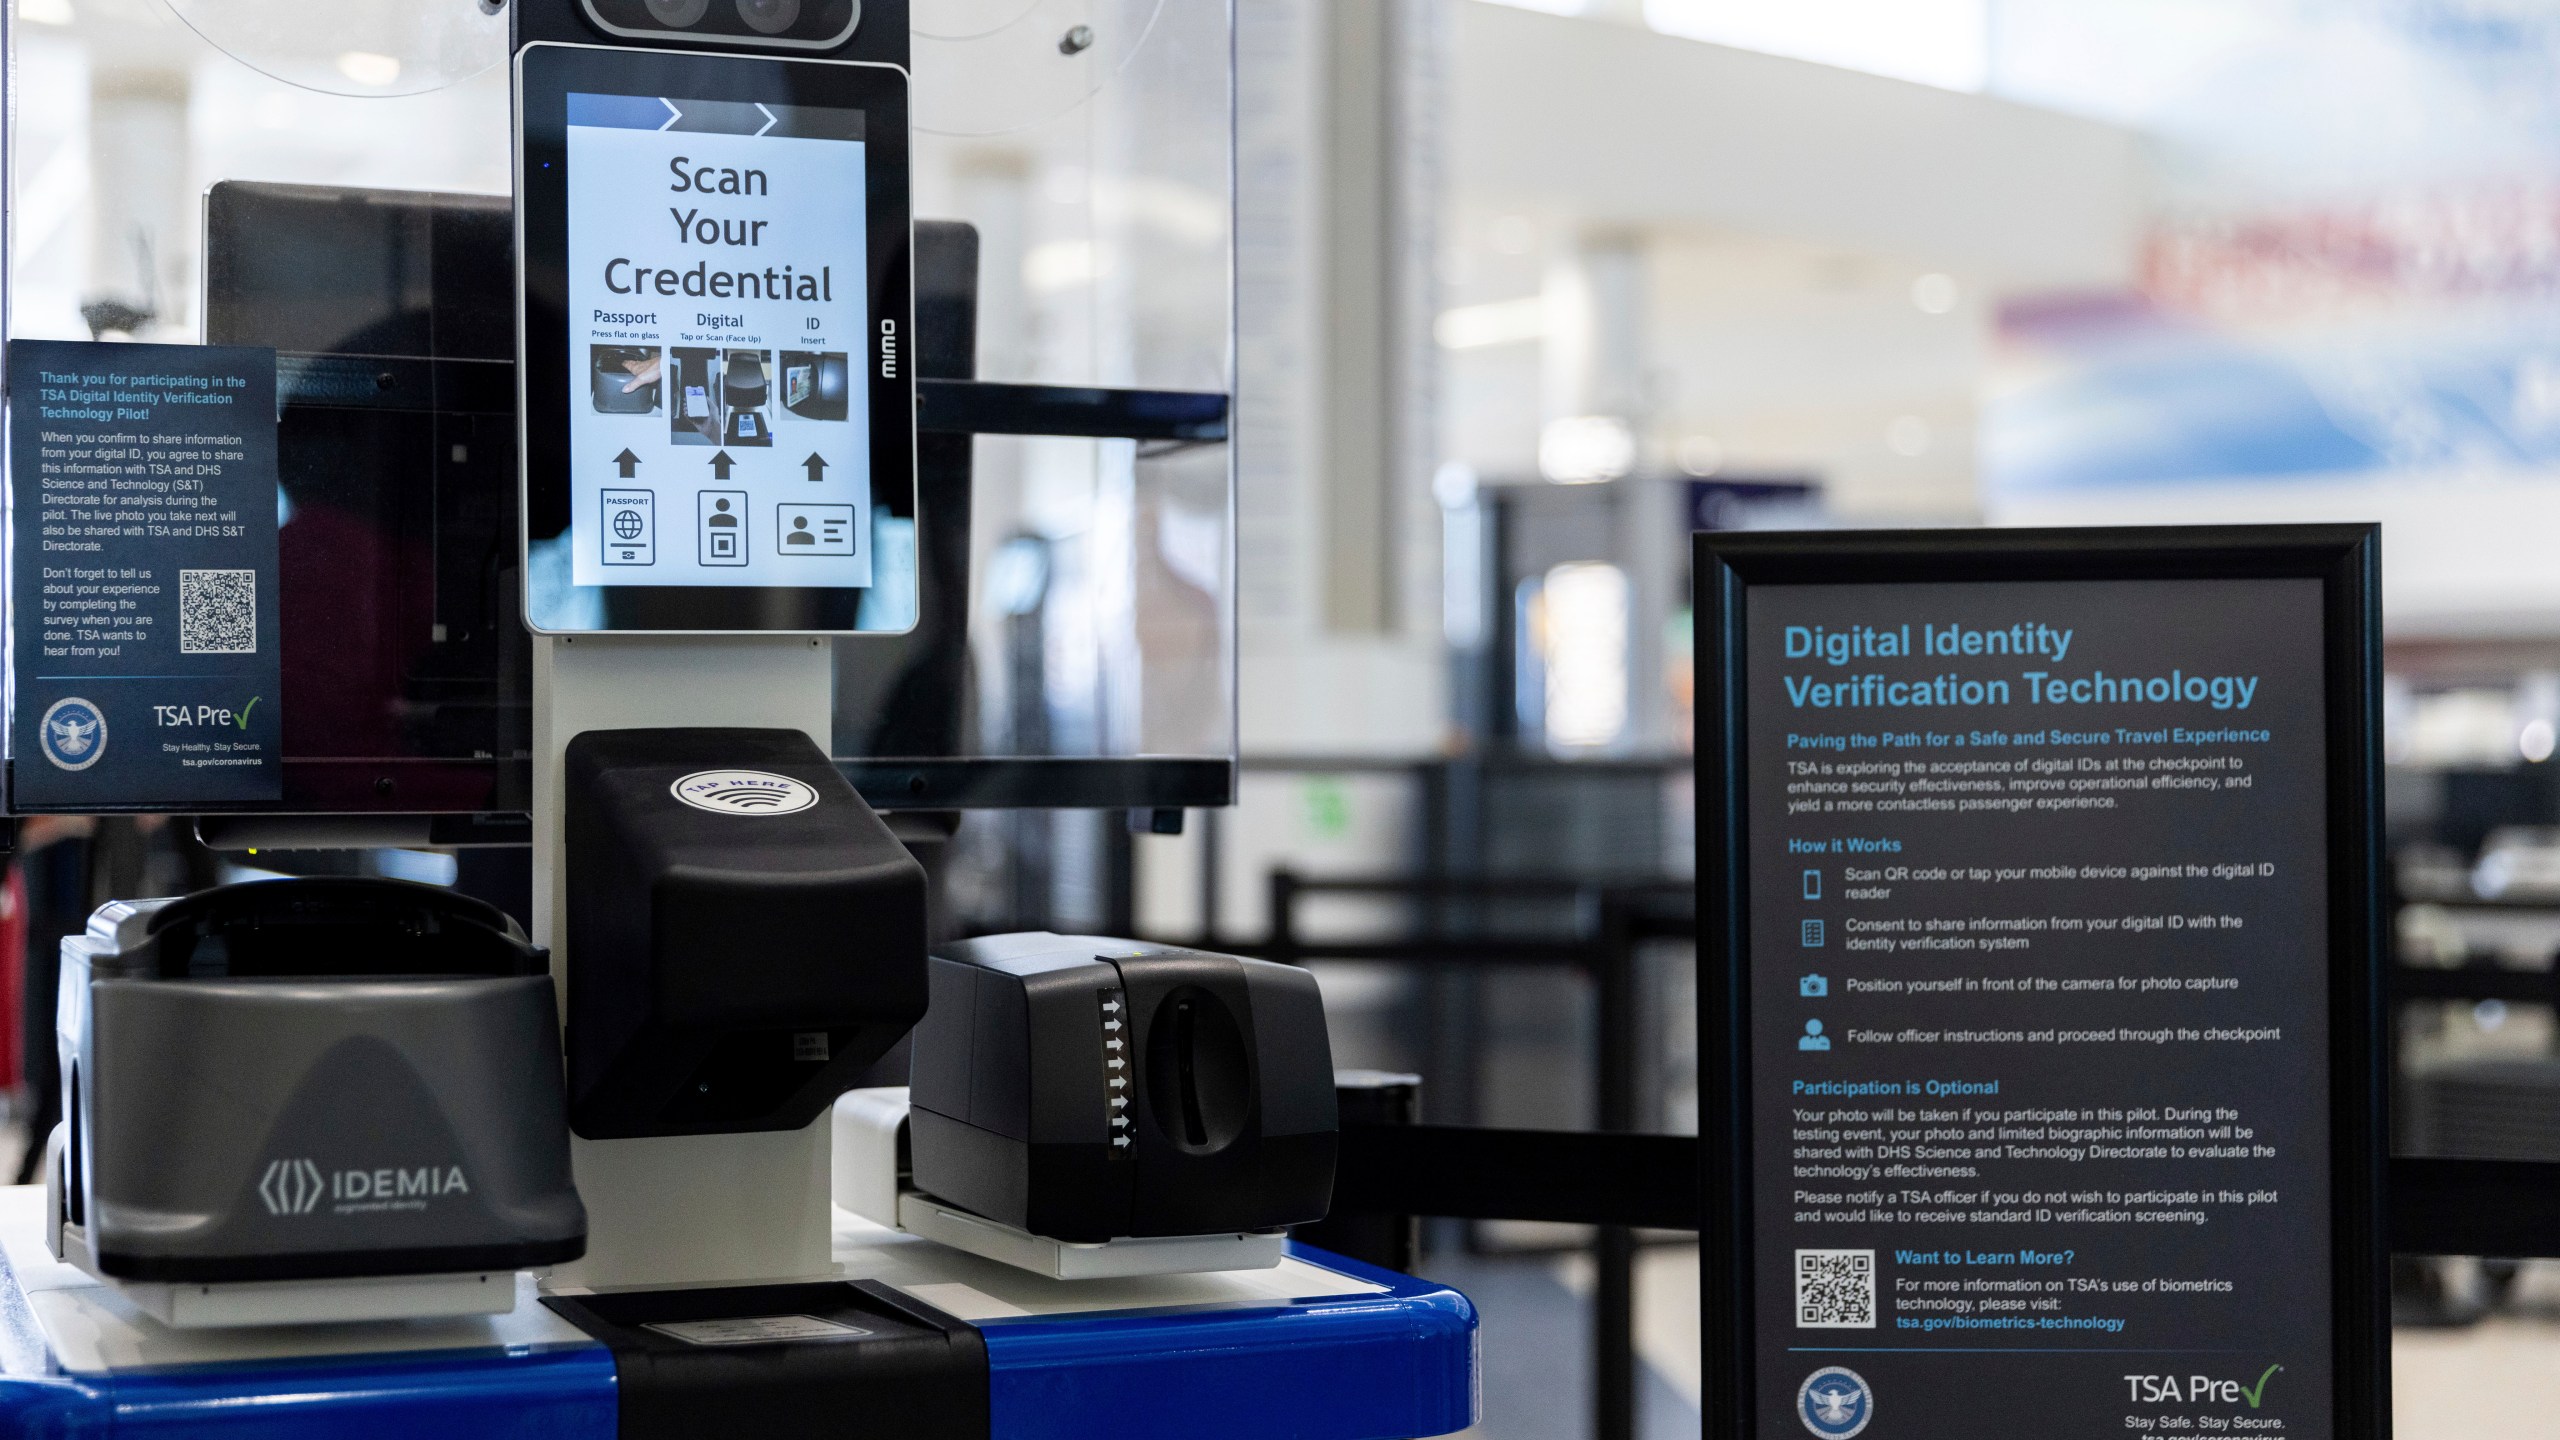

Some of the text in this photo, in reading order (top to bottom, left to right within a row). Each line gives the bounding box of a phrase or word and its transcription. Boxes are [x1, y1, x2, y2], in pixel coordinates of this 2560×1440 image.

[670, 156, 767, 196] Scan
[669, 207, 768, 246] Your
[604, 257, 832, 302] Credential
[594, 309, 657, 326] Passport
[696, 313, 743, 330] Digital
[806, 316, 820, 330] ID
[591, 329, 612, 338] Press
[614, 330, 627, 338] flat
[641, 331, 660, 340] glass
[680, 332, 694, 342] Tap
[705, 333, 724, 341] Scan
[725, 334, 746, 343] (Face
[747, 335, 761, 344] Up)
[800, 336, 826, 345] Insert
[881, 319, 896, 378] mimo
[39, 371, 246, 389] Thank you for participating in the
[39, 388, 232, 406] TSA Digital Identity Verification
[39, 406, 149, 422] Technology Pilot!
[40, 431, 242, 445] When you confirm to share information
[40, 446, 244, 462] from your digital ID, you agree to share
[41, 462, 221, 475] this information with TSA and DHS
[41, 477, 203, 493] Science and Technology (S&T)
[42, 493, 217, 508] Directorate for analysis during the
[42, 508, 236, 523] pilot. The live photo you take next will
[42, 524, 245, 537] also be shared with TSA and DHS S&T
[42, 539, 104, 551] Directorate.
[1785, 621, 2073, 666] Digital Identity
[1784, 669, 2258, 710] Verification Technology
[153, 705, 231, 726] TSA Pre
[1787, 727, 2270, 752] Paving the Path for a Safe and Secure Travel Experience
[182, 757, 262, 768] tsa.gov/coronavirus
[1787, 756, 2243, 777] TSA is exploring the acceptance of digital IDs at the checkpoint to
[686, 780, 791, 793] TAP HERE
[1788, 837, 1902, 853] How it Works
[1846, 975, 2239, 994] Position yourself in front of the camera for photo capture
[1847, 1026, 2281, 1044] Follow officer instructions and proceed through the checkpoint
[1792, 1079, 1999, 1098] Participation is Optional
[333, 1166, 468, 1199] IDEMIA
[1894, 1249, 2075, 1265] Want to Learn More?
[1895, 1296, 2062, 1313] technology, please visit:
[1896, 1315, 2125, 1332] tsa.gov/biometrics-technology
[2124, 1375, 2240, 1402] TSA Pre
[2124, 1415, 2285, 1431] Stay Safe. Stay Secure.
